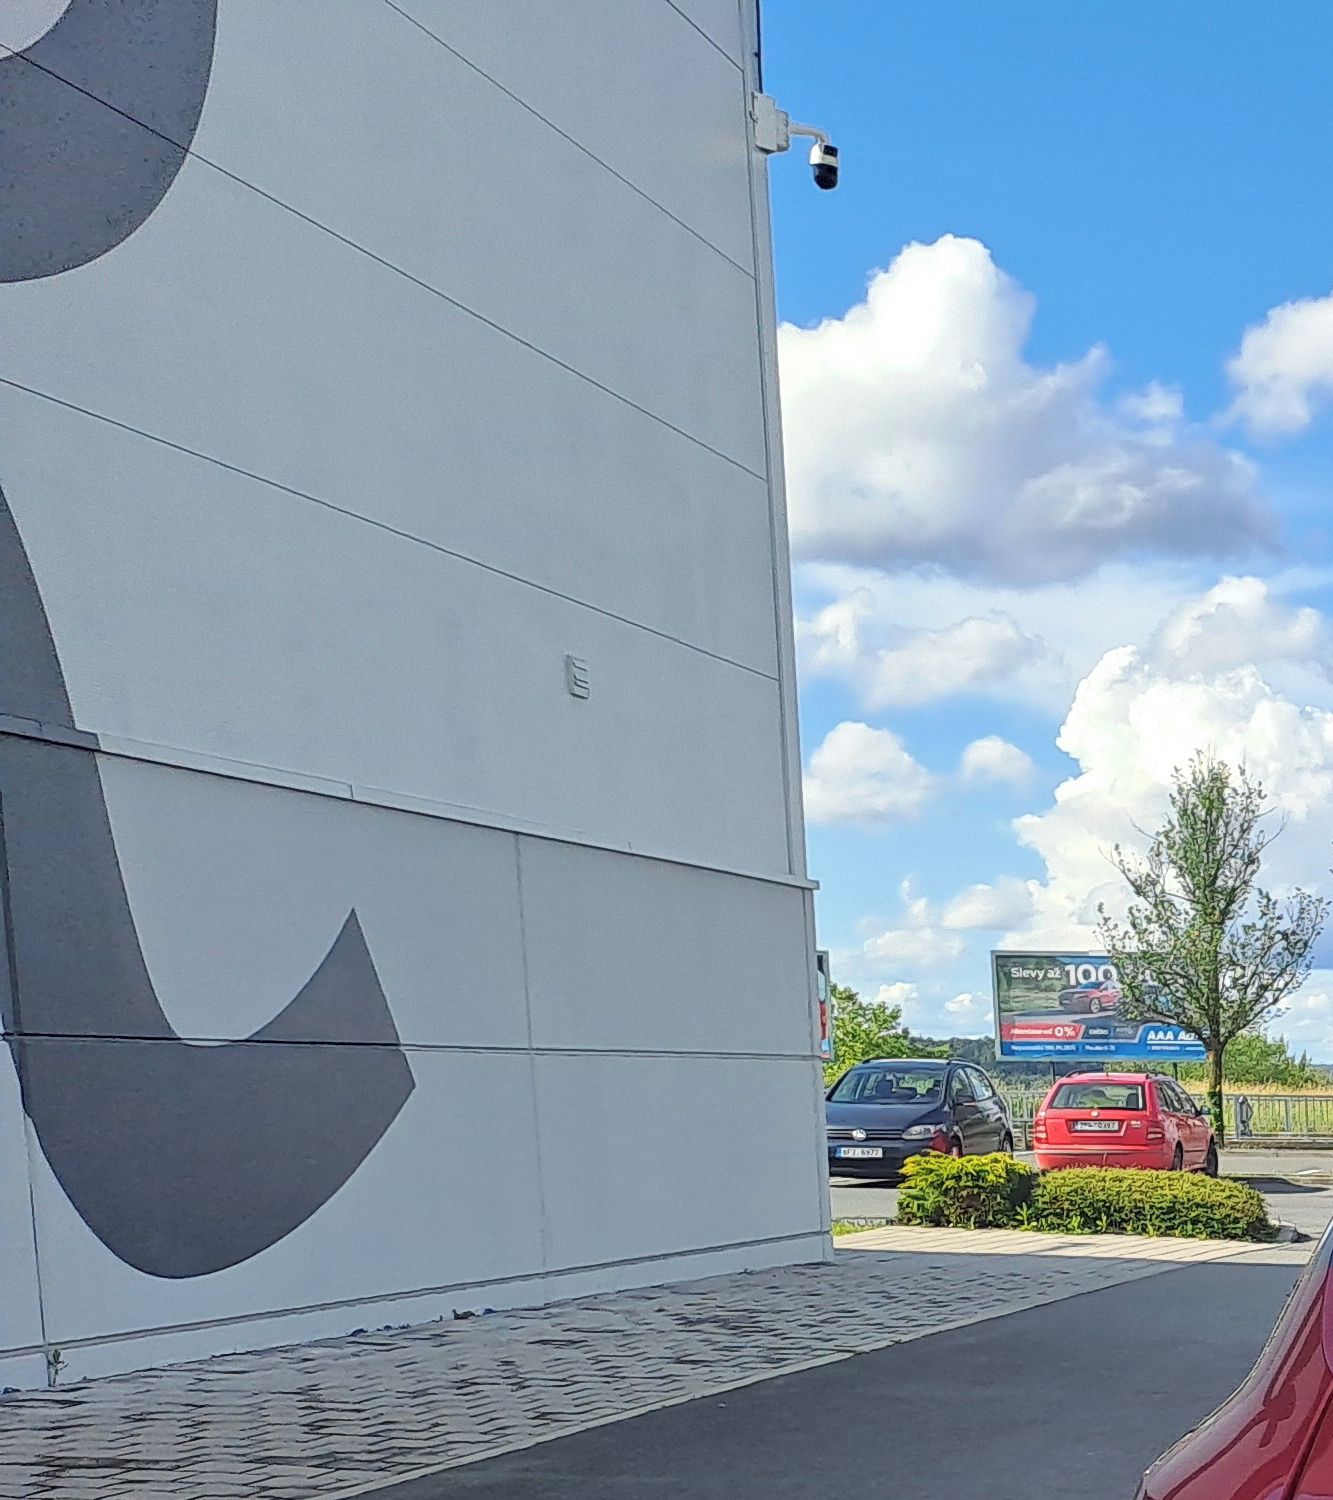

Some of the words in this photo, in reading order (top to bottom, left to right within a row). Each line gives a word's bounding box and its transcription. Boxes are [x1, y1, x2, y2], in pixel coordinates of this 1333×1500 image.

[1010, 967, 1045, 980] Slevy
[1046, 967, 1061, 978] až
[1147, 1030, 1175, 1041] AAA
